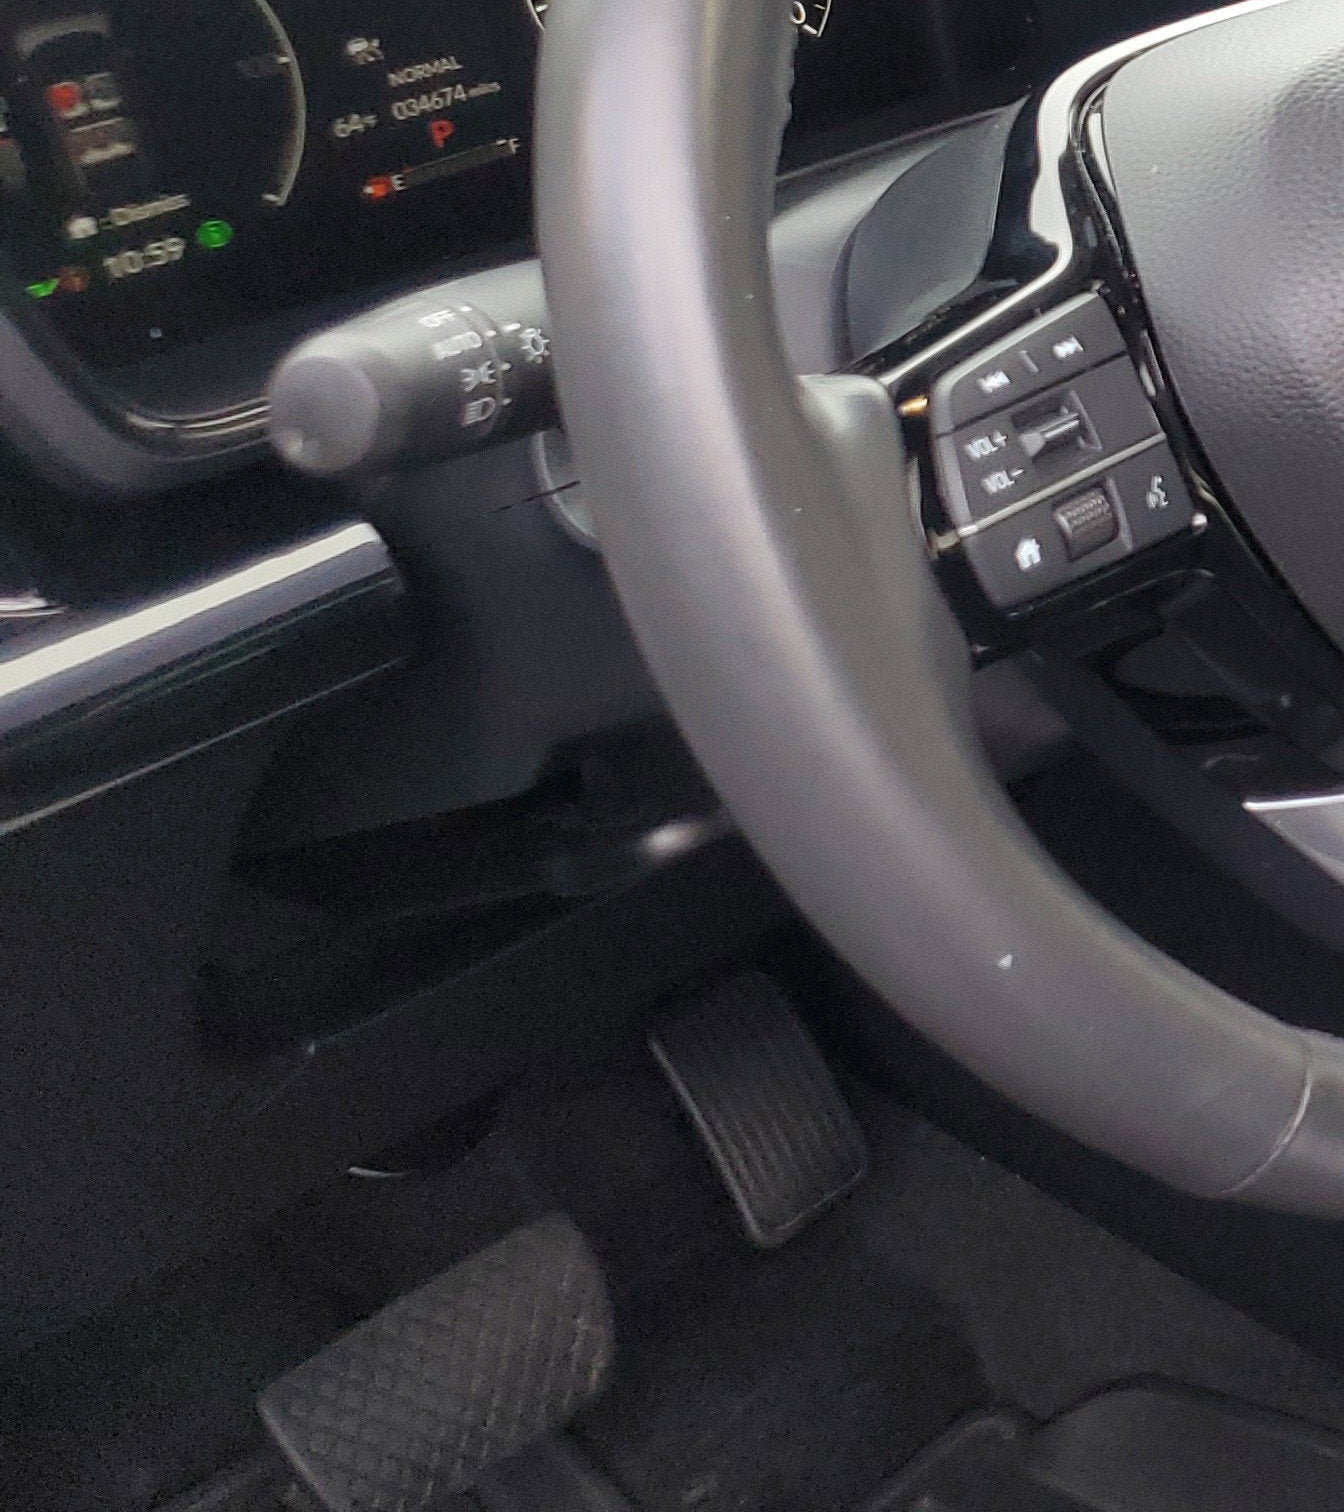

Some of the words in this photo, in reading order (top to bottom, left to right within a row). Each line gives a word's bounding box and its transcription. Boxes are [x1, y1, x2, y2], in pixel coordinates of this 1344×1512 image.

[388, 56, 463, 87] NORMAL
[392, 84, 466, 120] 034674
[430, 120, 454, 149] P
[433, 331, 483, 360] AUTO
